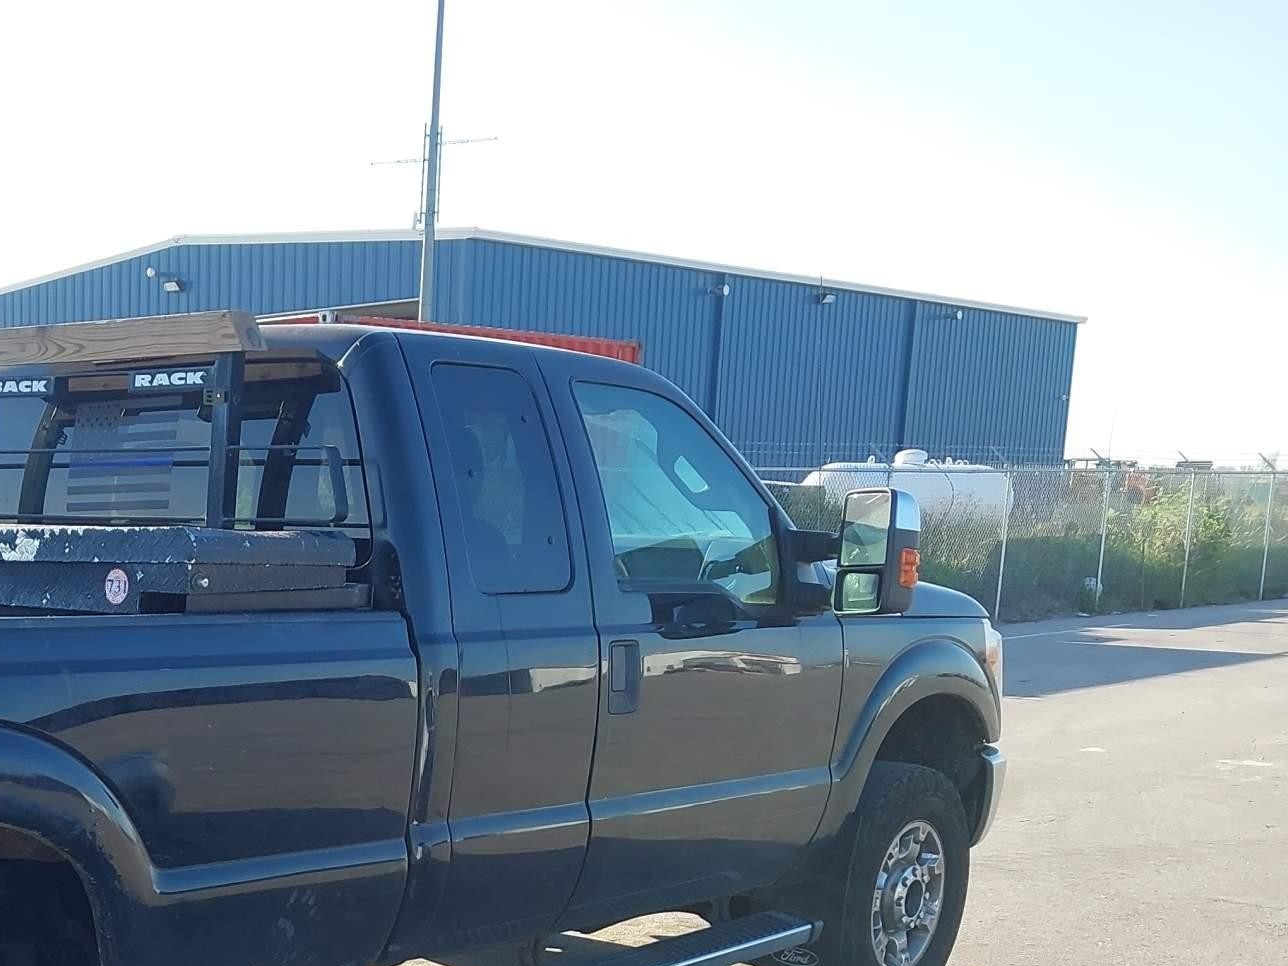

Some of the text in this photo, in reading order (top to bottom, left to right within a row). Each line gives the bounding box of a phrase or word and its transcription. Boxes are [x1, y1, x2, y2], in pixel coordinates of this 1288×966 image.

[134, 371, 205, 387] RACK
[106, 579, 127, 594] 731
[780, 949, 810, 964] Ford
